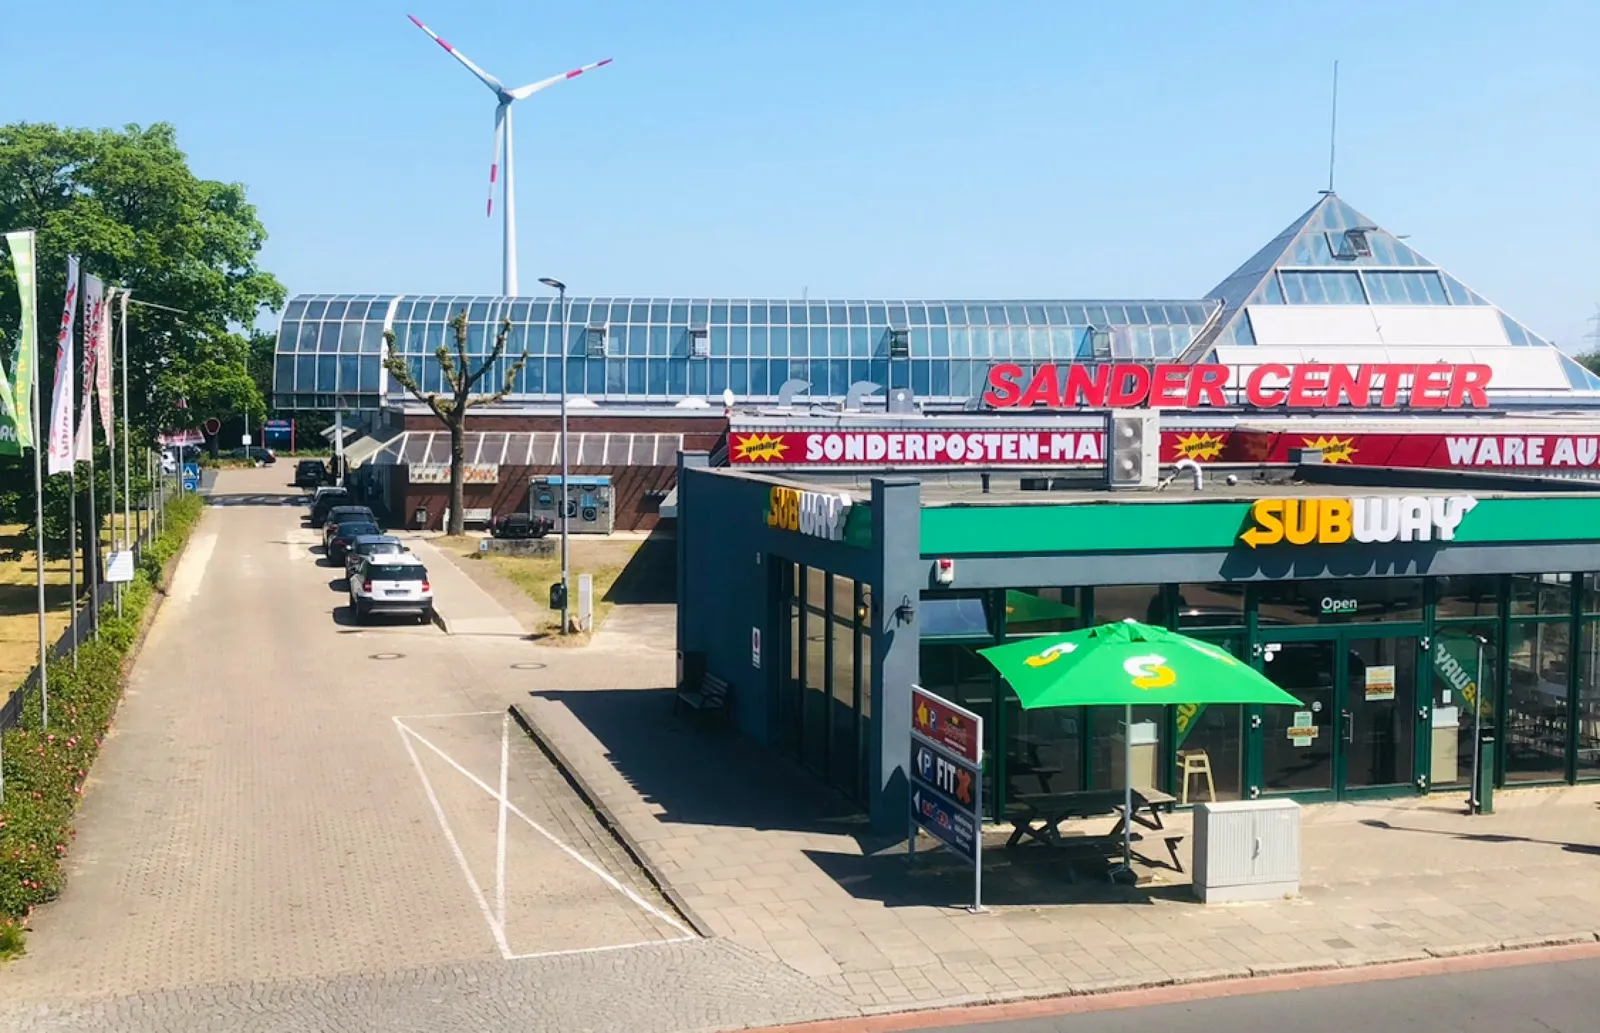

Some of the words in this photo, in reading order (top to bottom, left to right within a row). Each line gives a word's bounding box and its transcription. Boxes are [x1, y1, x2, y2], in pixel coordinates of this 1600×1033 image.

[984, 363, 1230, 408] SANDER
[1246, 362, 1493, 408] CENTER
[1445, 436, 1546, 466] WARE
[1550, 436, 1600, 467] AU
[767, 486, 853, 541] SUBWAY
[1240, 494, 1478, 549] SUBWAY
[1321, 597, 1358, 613] Open
